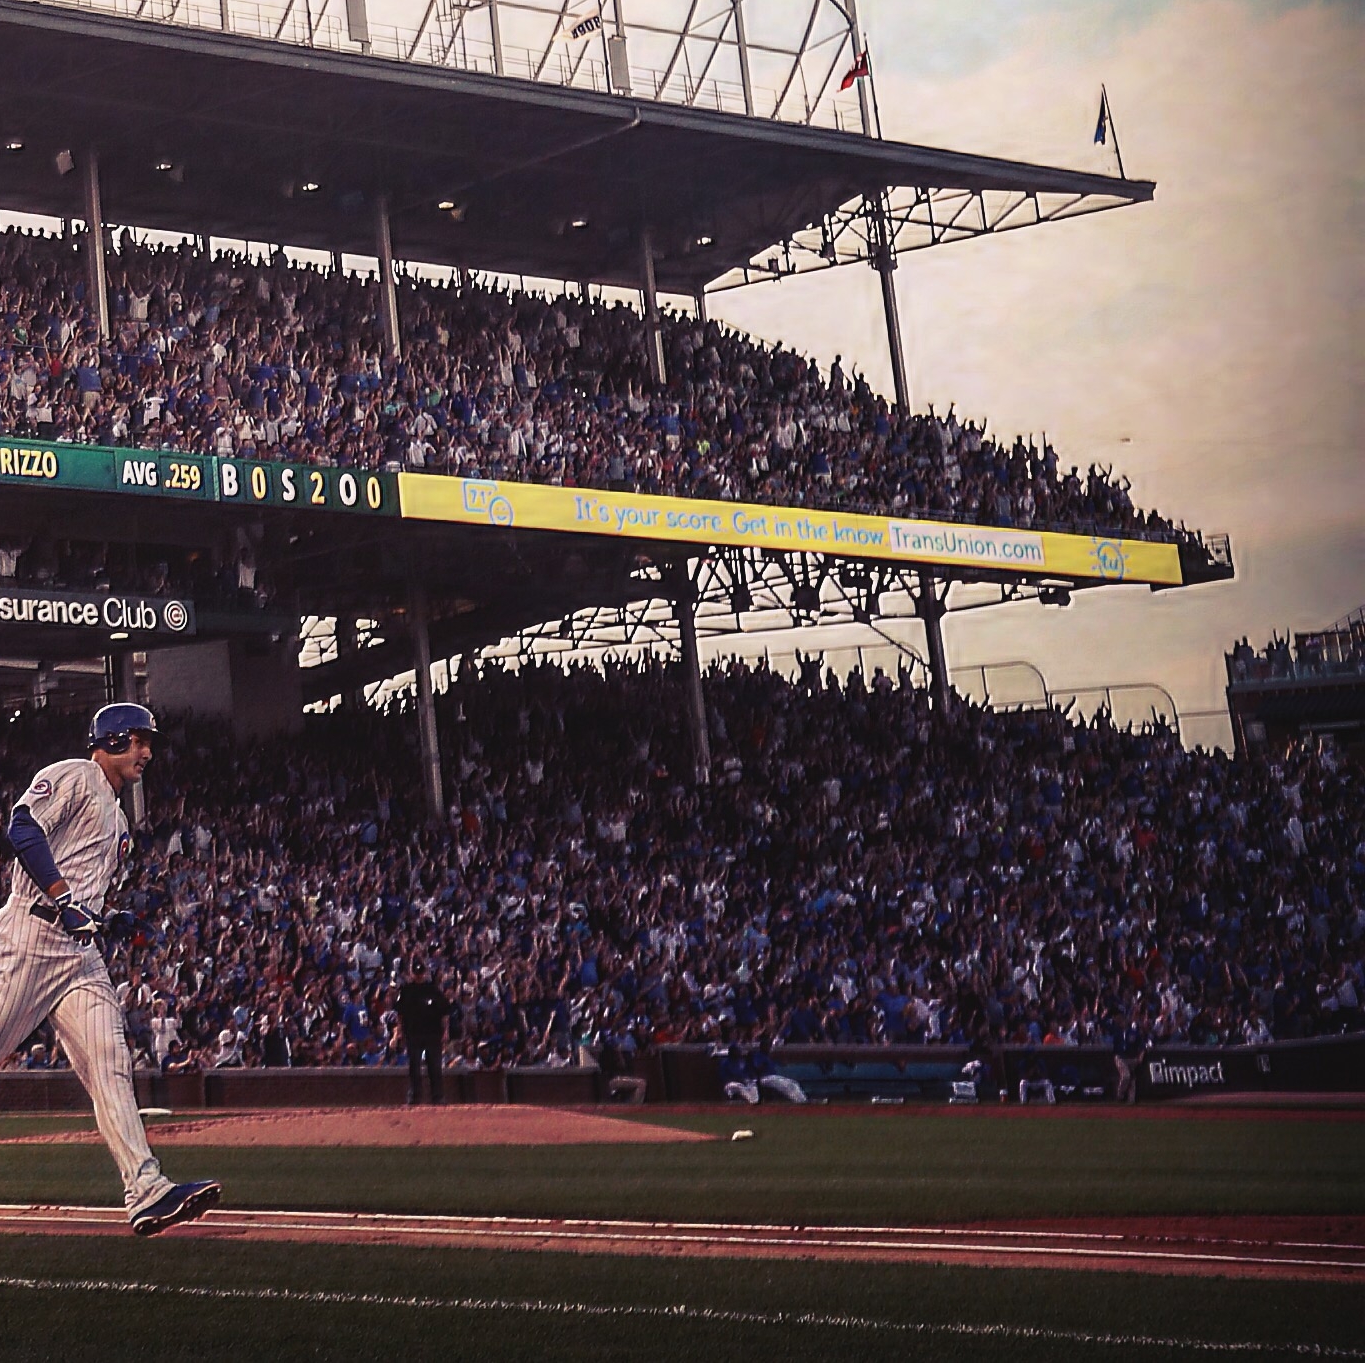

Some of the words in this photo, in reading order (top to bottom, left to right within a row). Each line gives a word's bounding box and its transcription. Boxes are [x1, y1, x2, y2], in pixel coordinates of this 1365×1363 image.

[0, 447, 58, 479] RIZZO
[122, 460, 158, 486] AVG
[164, 463, 201, 490] .259
[222, 463, 239, 496] B
[251, 466, 266, 499] 0
[281, 468, 296, 501] S
[310, 471, 325, 504] 2
[367, 476, 381, 509] 0
[575, 496, 609, 522] It's
[615, 506, 661, 531] your
[733, 511, 768, 536] Get
[774, 516, 792, 538] in
[797, 517, 829, 542] the
[892, 527, 1043, 560] TransUnion.com
[103, 597, 157, 629] Club
[1161, 1057, 1225, 1088] impact
